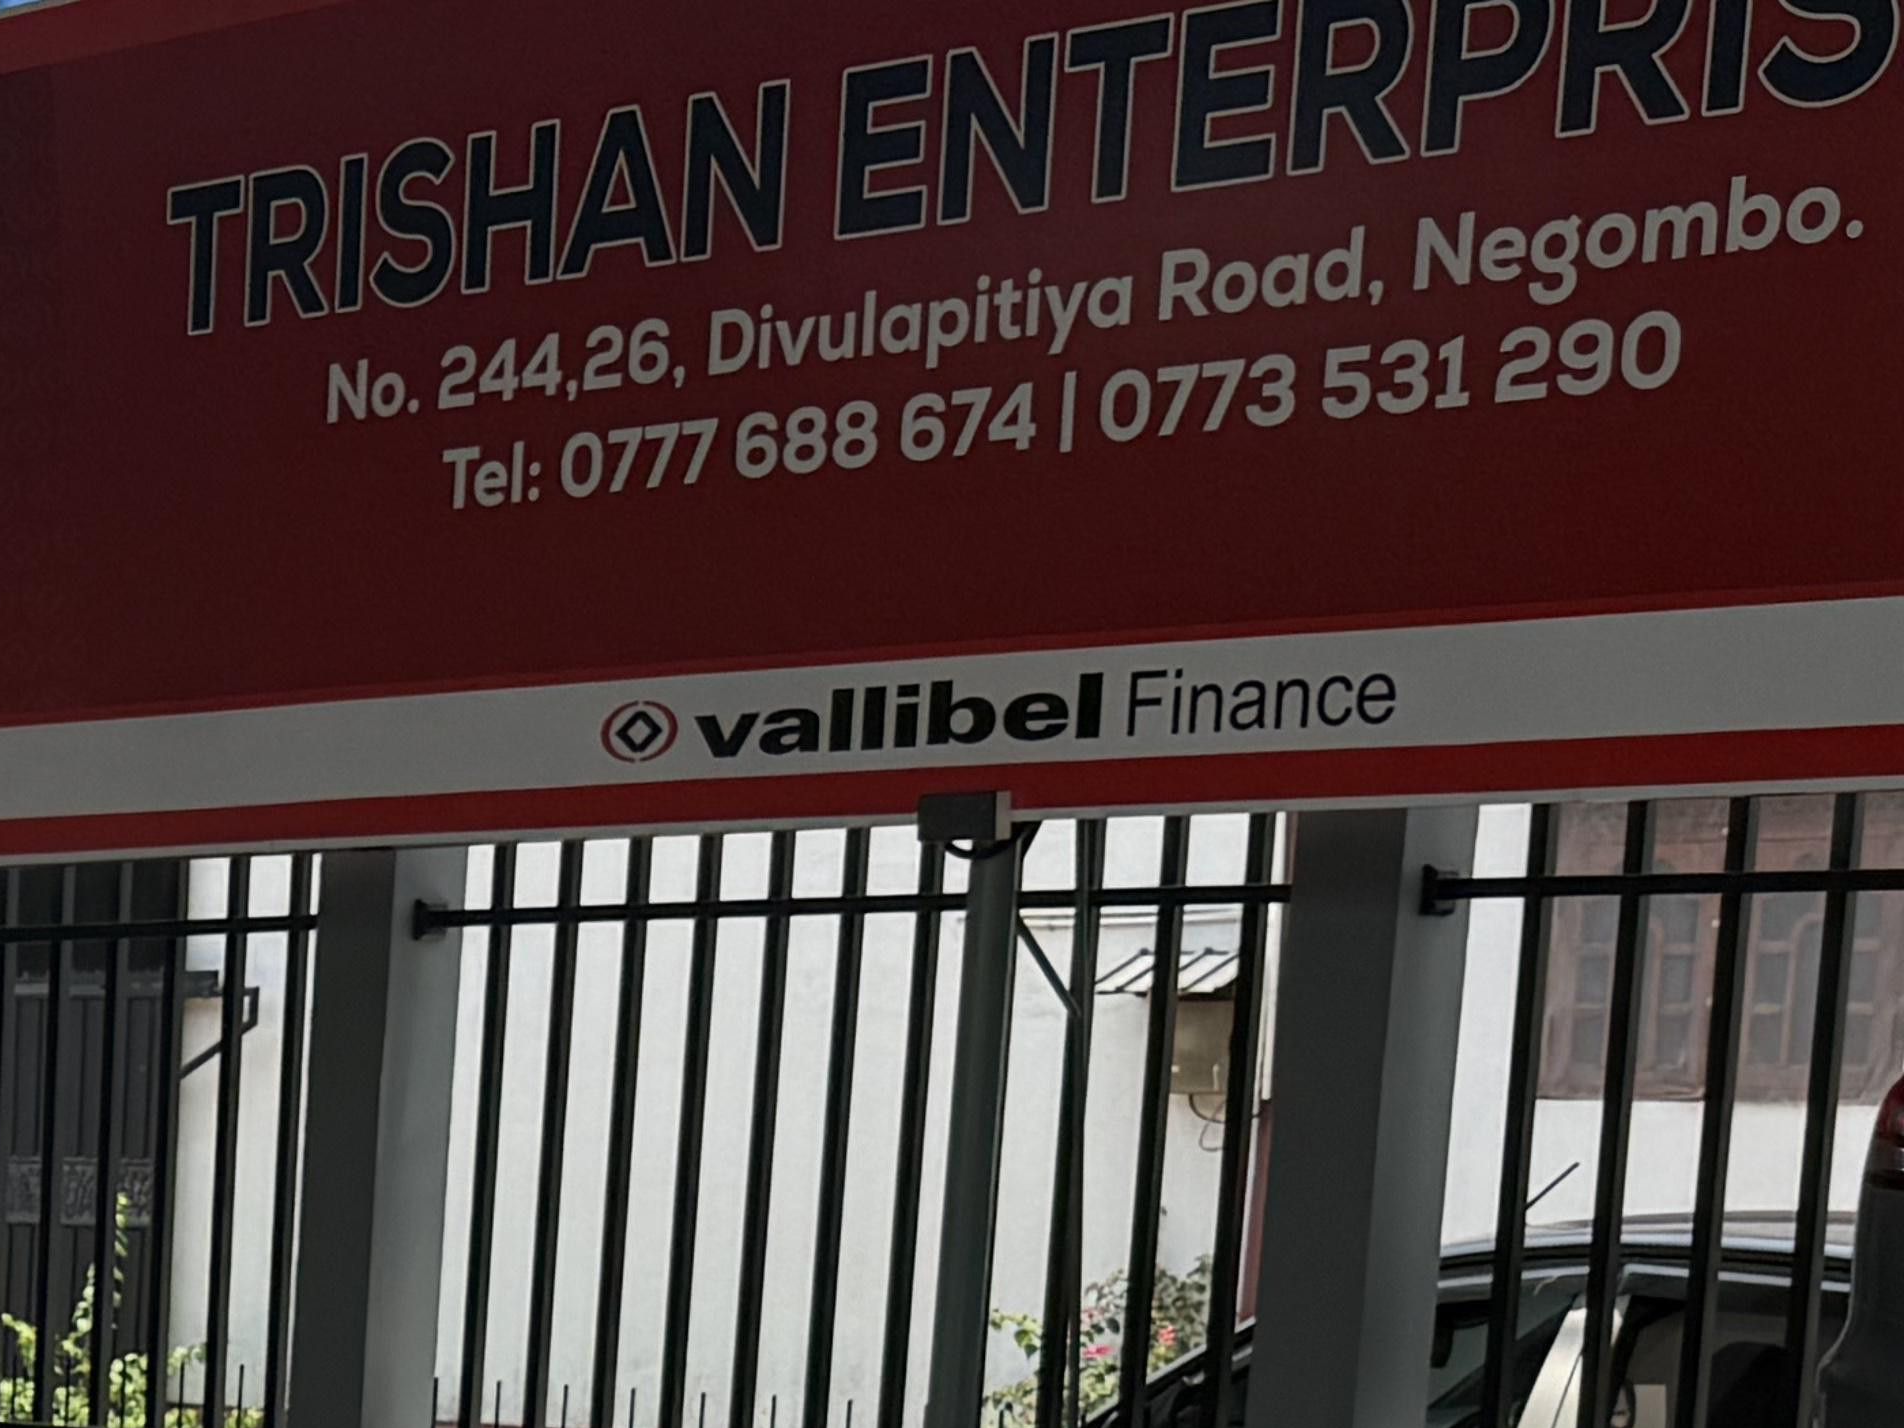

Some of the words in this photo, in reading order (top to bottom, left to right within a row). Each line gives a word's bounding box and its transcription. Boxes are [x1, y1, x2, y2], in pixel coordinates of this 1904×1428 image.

[166, 78, 791, 336] TRISHAN
[326, 358, 420, 425] No.
[437, 318, 687, 410] 244,26,
[707, 268, 1133, 376] Divulapitiya
[1157, 225, 1384, 322] Road,
[1411, 175, 1865, 305] Negombo.
[442, 439, 543, 510] Tel:
[560, 417, 720, 499] 0777
[734, 400, 878, 480] 688
[899, 381, 1036, 462] 674
[1099, 353, 1297, 443] 0773
[1321, 334, 1470, 418] 531
[1493, 310, 1682, 405] 290
[693, 671, 1104, 759] vallibel
[1126, 667, 1398, 738] Finance
